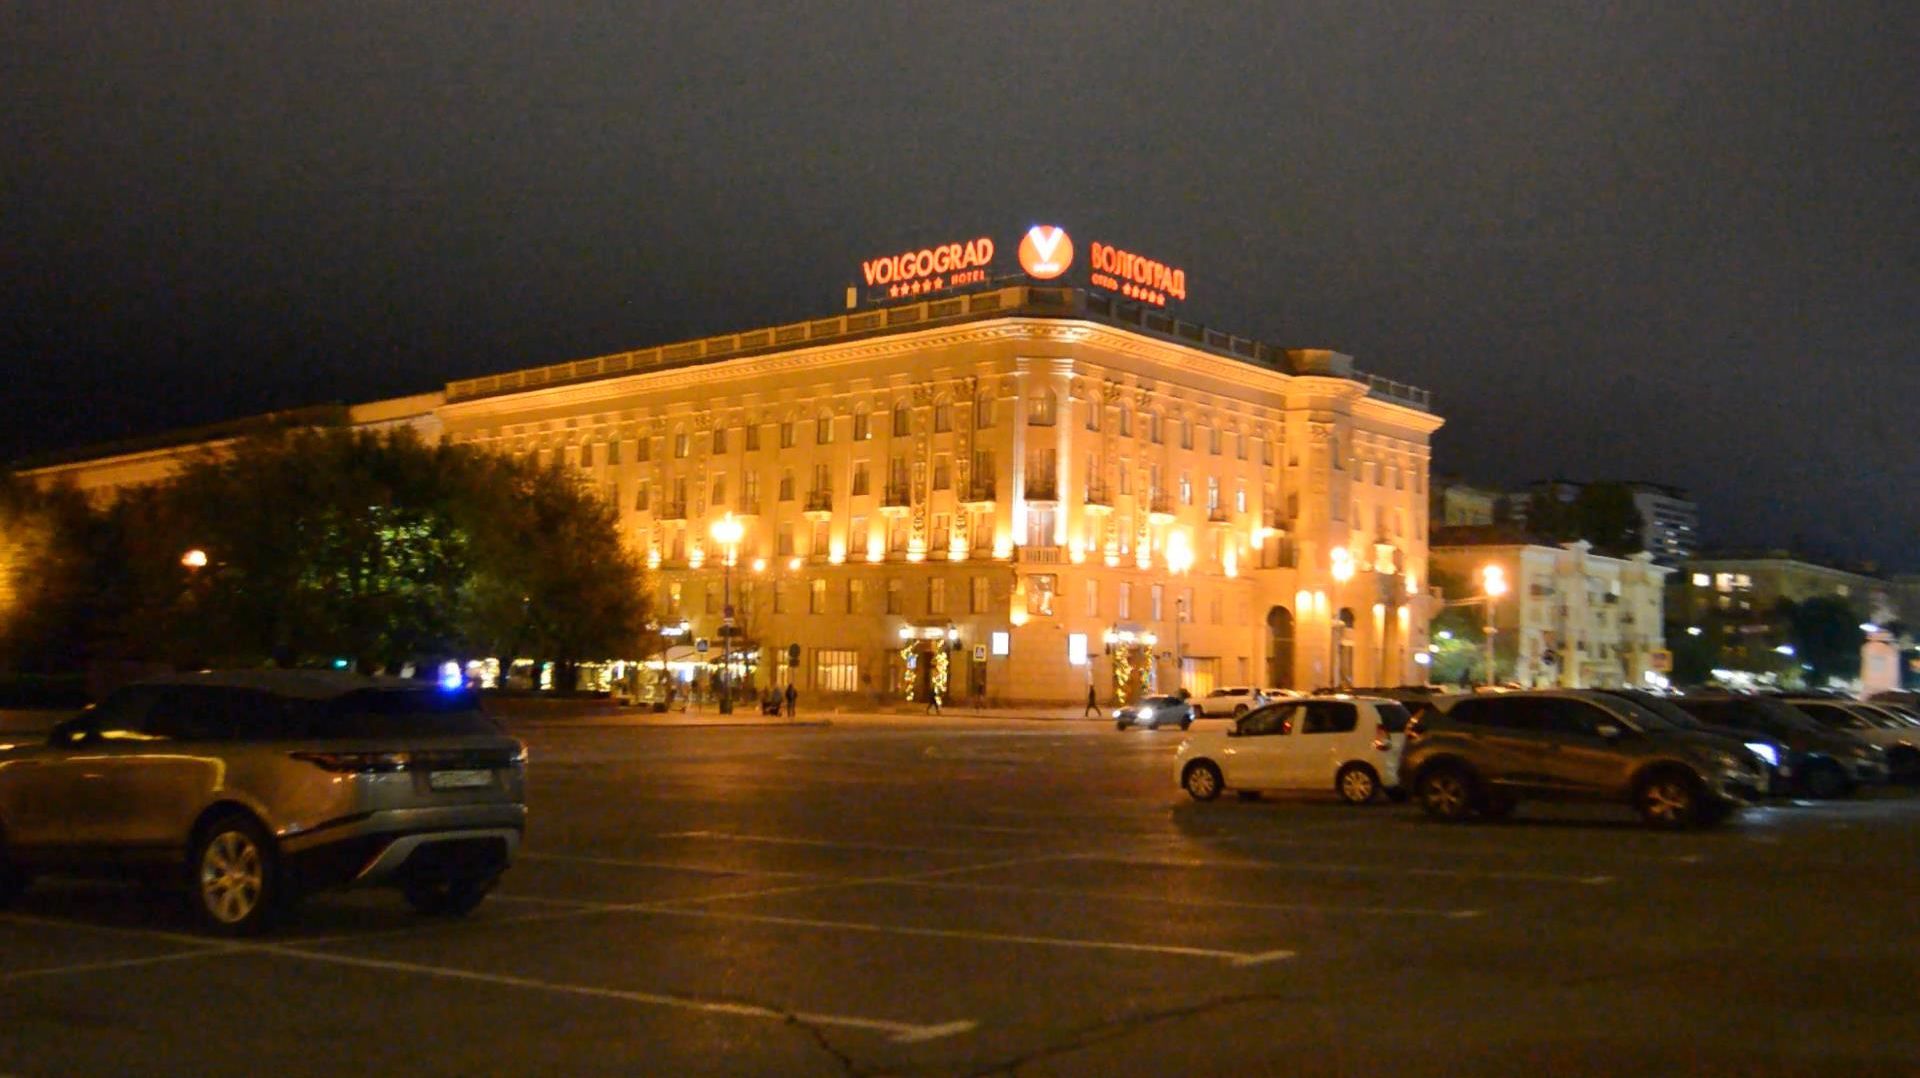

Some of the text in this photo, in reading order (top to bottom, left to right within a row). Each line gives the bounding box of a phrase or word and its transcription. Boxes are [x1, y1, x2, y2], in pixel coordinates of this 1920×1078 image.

[863, 238, 994, 286] VOLGOGRAD
[1028, 225, 1064, 263] V
[950, 270, 985, 286] HOTEL
[1091, 241, 1186, 300] ВОЛГОГРАД
